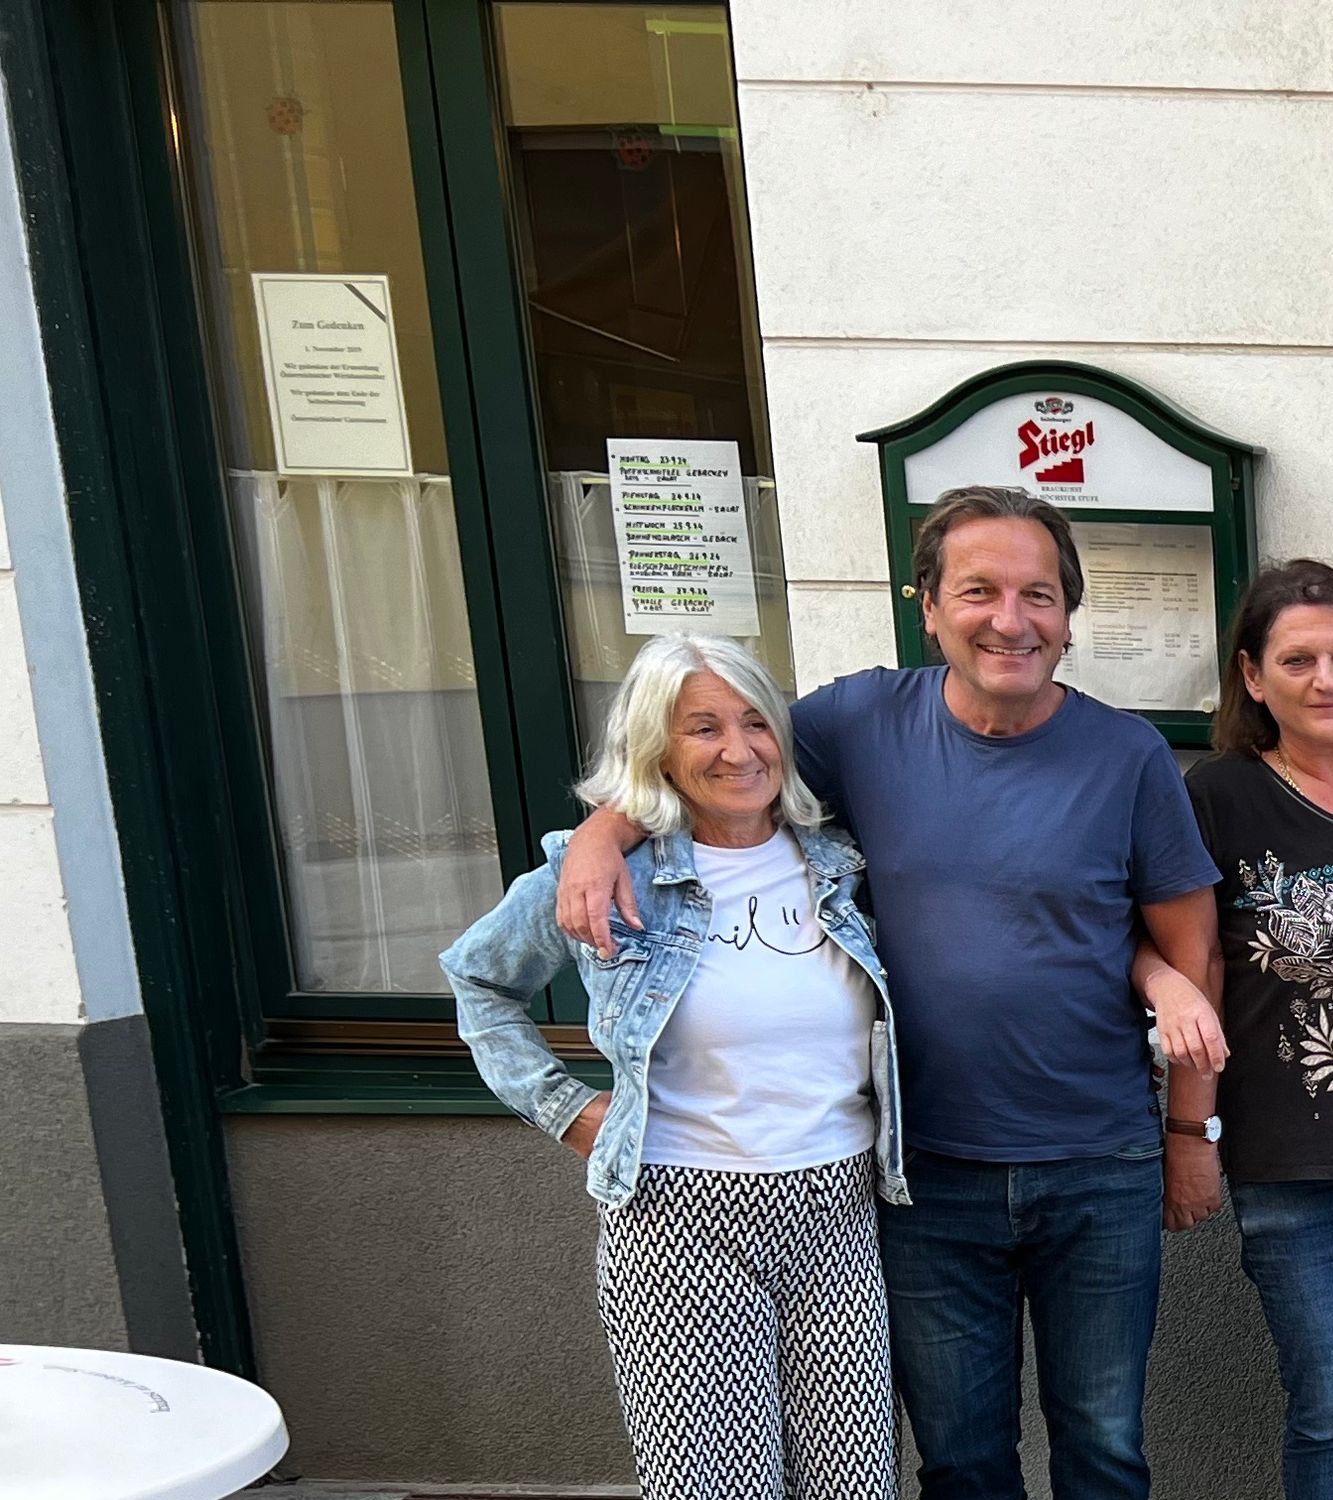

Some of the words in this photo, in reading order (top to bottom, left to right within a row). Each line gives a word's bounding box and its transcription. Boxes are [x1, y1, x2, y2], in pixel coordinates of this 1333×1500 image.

[292, 320, 314, 329] Zum
[317, 320, 365, 330] Gedenken
[1017, 419, 1096, 470] Stiegl
